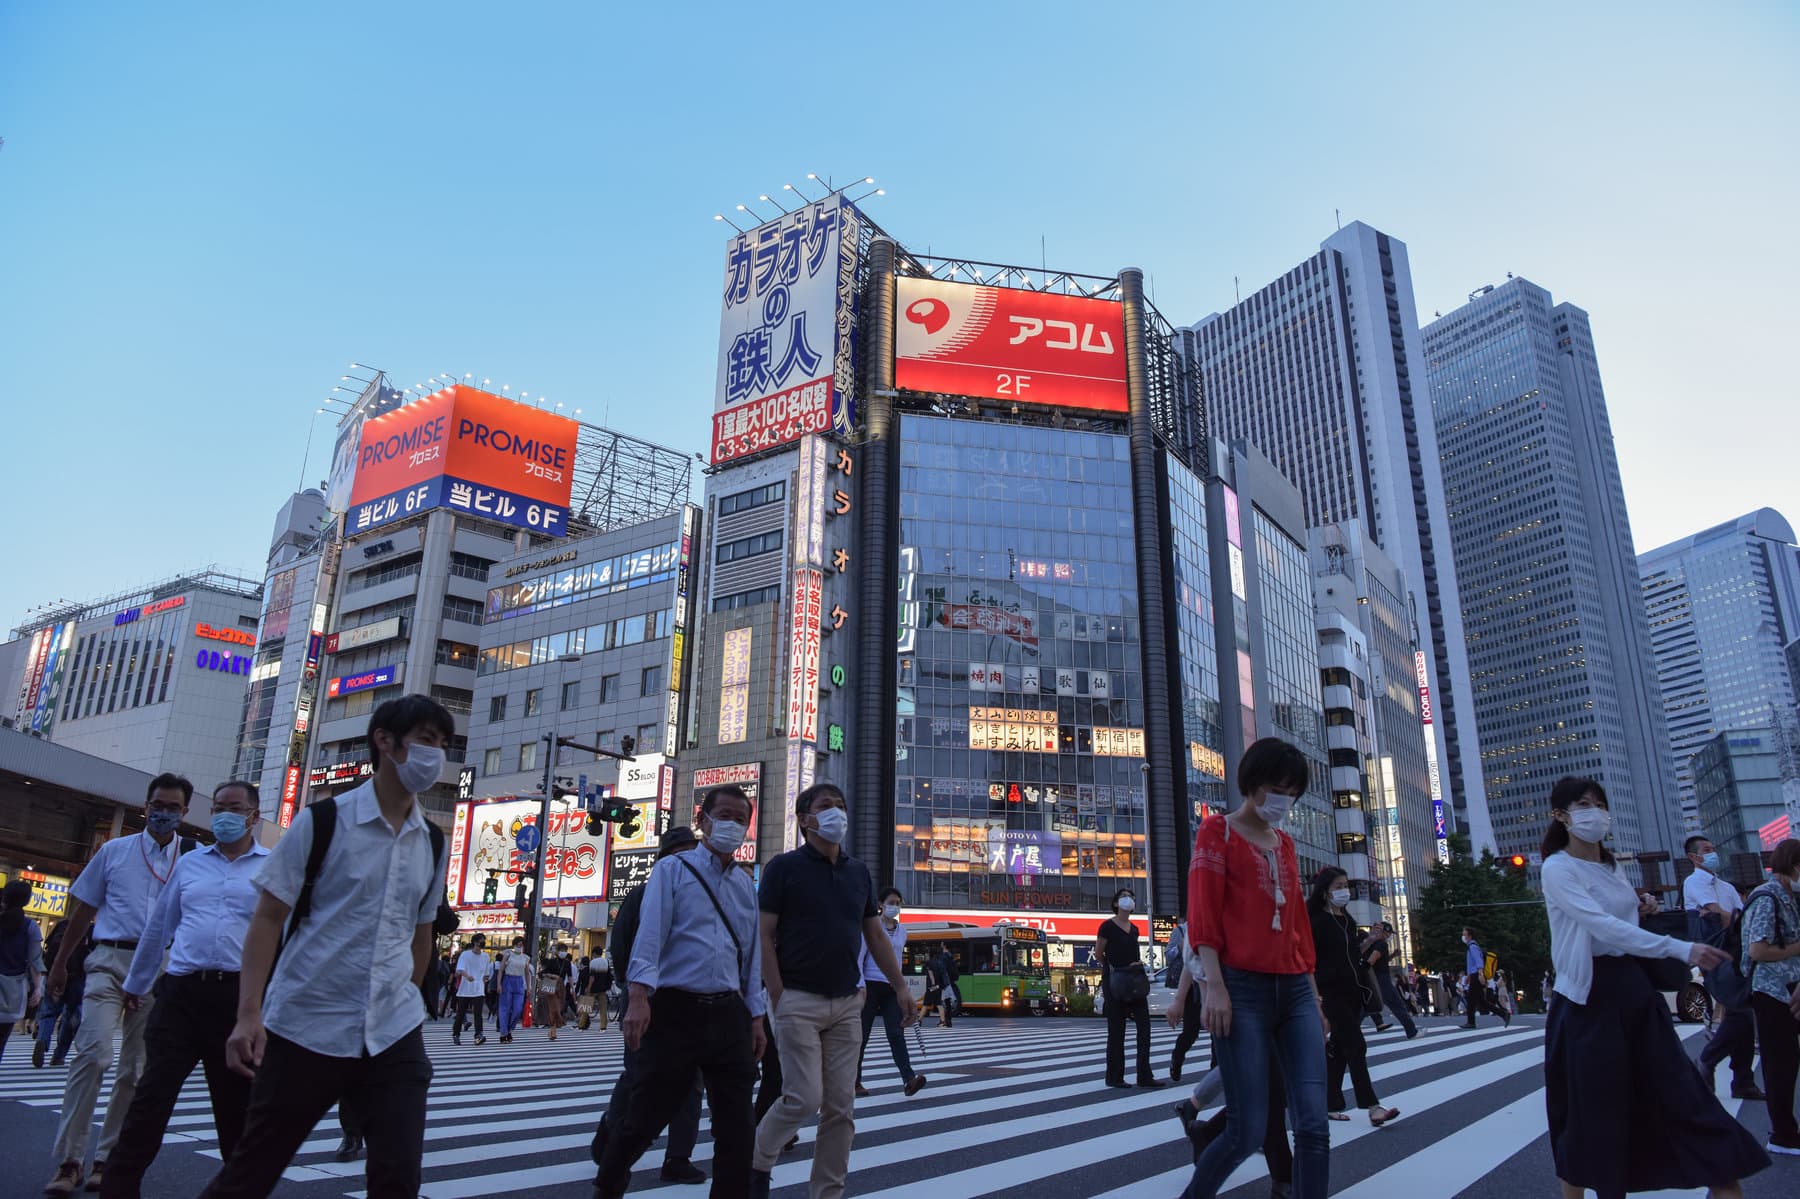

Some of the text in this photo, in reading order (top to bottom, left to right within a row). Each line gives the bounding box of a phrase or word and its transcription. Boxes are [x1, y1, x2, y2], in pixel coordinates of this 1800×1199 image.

[725, 203, 838, 310] カラオケ
[763, 283, 791, 327] の
[833, 206, 858, 434] カラオケの鉄人
[1008, 315, 1115, 355] アコム
[725, 311, 822, 404] 鉄人
[996, 374, 1032, 395] 2F
[361, 416, 446, 470] PROMISE
[458, 418, 568, 470] PROMISE
[408, 446, 440, 468] プロミス
[525, 462, 563, 483] プロミス
[357, 485, 429, 529] 当ビル 6F
[449, 482, 560, 530] 当ビル 6F
[803, 569, 823, 741] 100名収容大パーティールーム
[971, 668, 1107, 691] 焼肉 六歌仙
[972, 723, 1055, 738] やきとり家
[990, 735, 1040, 750] すみれ
[1095, 728, 1125, 743] 新宿
[459, 771, 472, 787] 24
[627, 769, 641, 782] SS
[449, 825, 464, 886] カラオケ
[615, 853, 655, 868] ビリヤード
[990, 843, 1043, 871] 大戸屋
[981, 891, 1072, 906] SUN FLOWER
[481, 911, 507, 925] カラオケ
